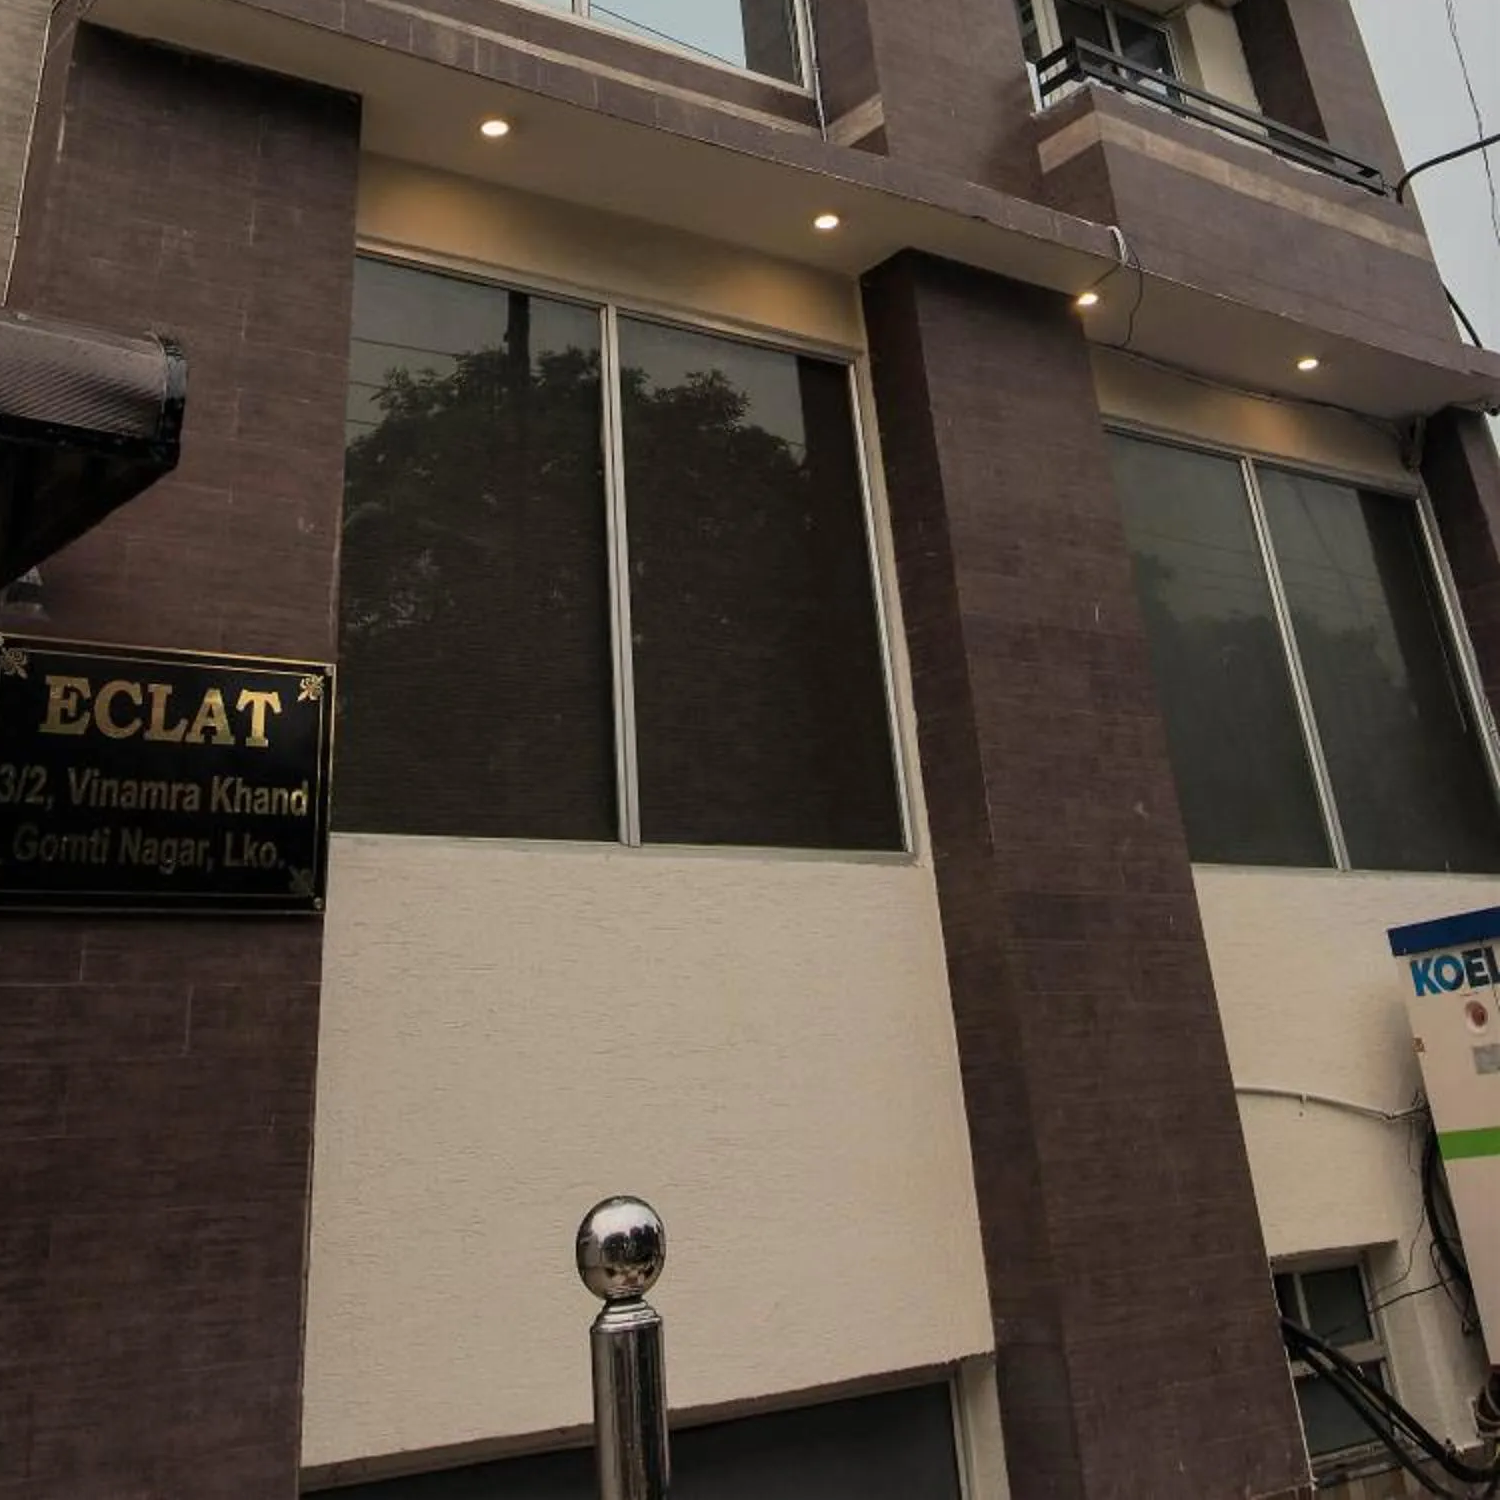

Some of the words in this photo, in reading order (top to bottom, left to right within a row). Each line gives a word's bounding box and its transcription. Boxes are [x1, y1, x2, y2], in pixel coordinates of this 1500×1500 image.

[38, 674, 283, 748] ECLAT
[67, 765, 202, 812] Vinamra
[210, 774, 310, 817] Khand
[11, 821, 111, 865] Gomti
[117, 825, 215, 876] Nagar,
[221, 828, 286, 871] Lko.
